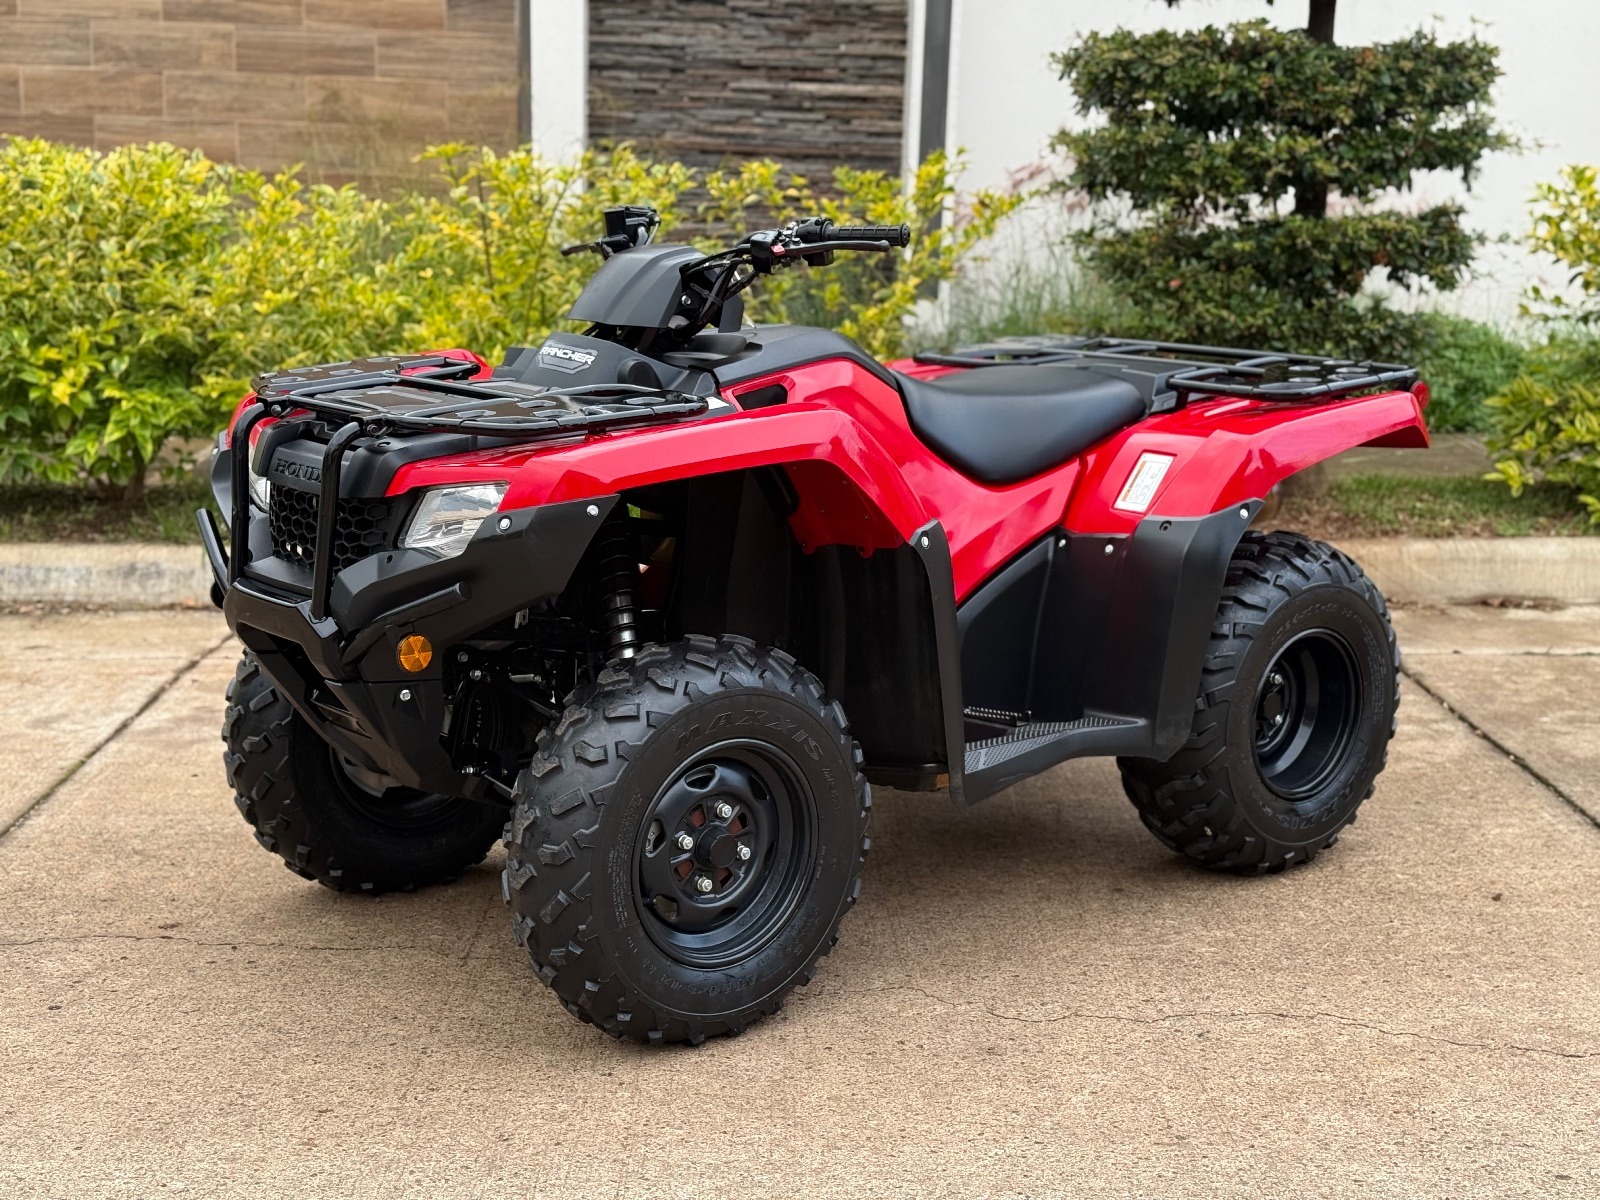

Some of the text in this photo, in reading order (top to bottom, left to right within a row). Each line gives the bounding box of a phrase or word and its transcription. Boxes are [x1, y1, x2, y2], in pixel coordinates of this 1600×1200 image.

[540, 346, 596, 365] RANCHER
[273, 458, 323, 484] HOND
[673, 709, 825, 761] MAXXIS
